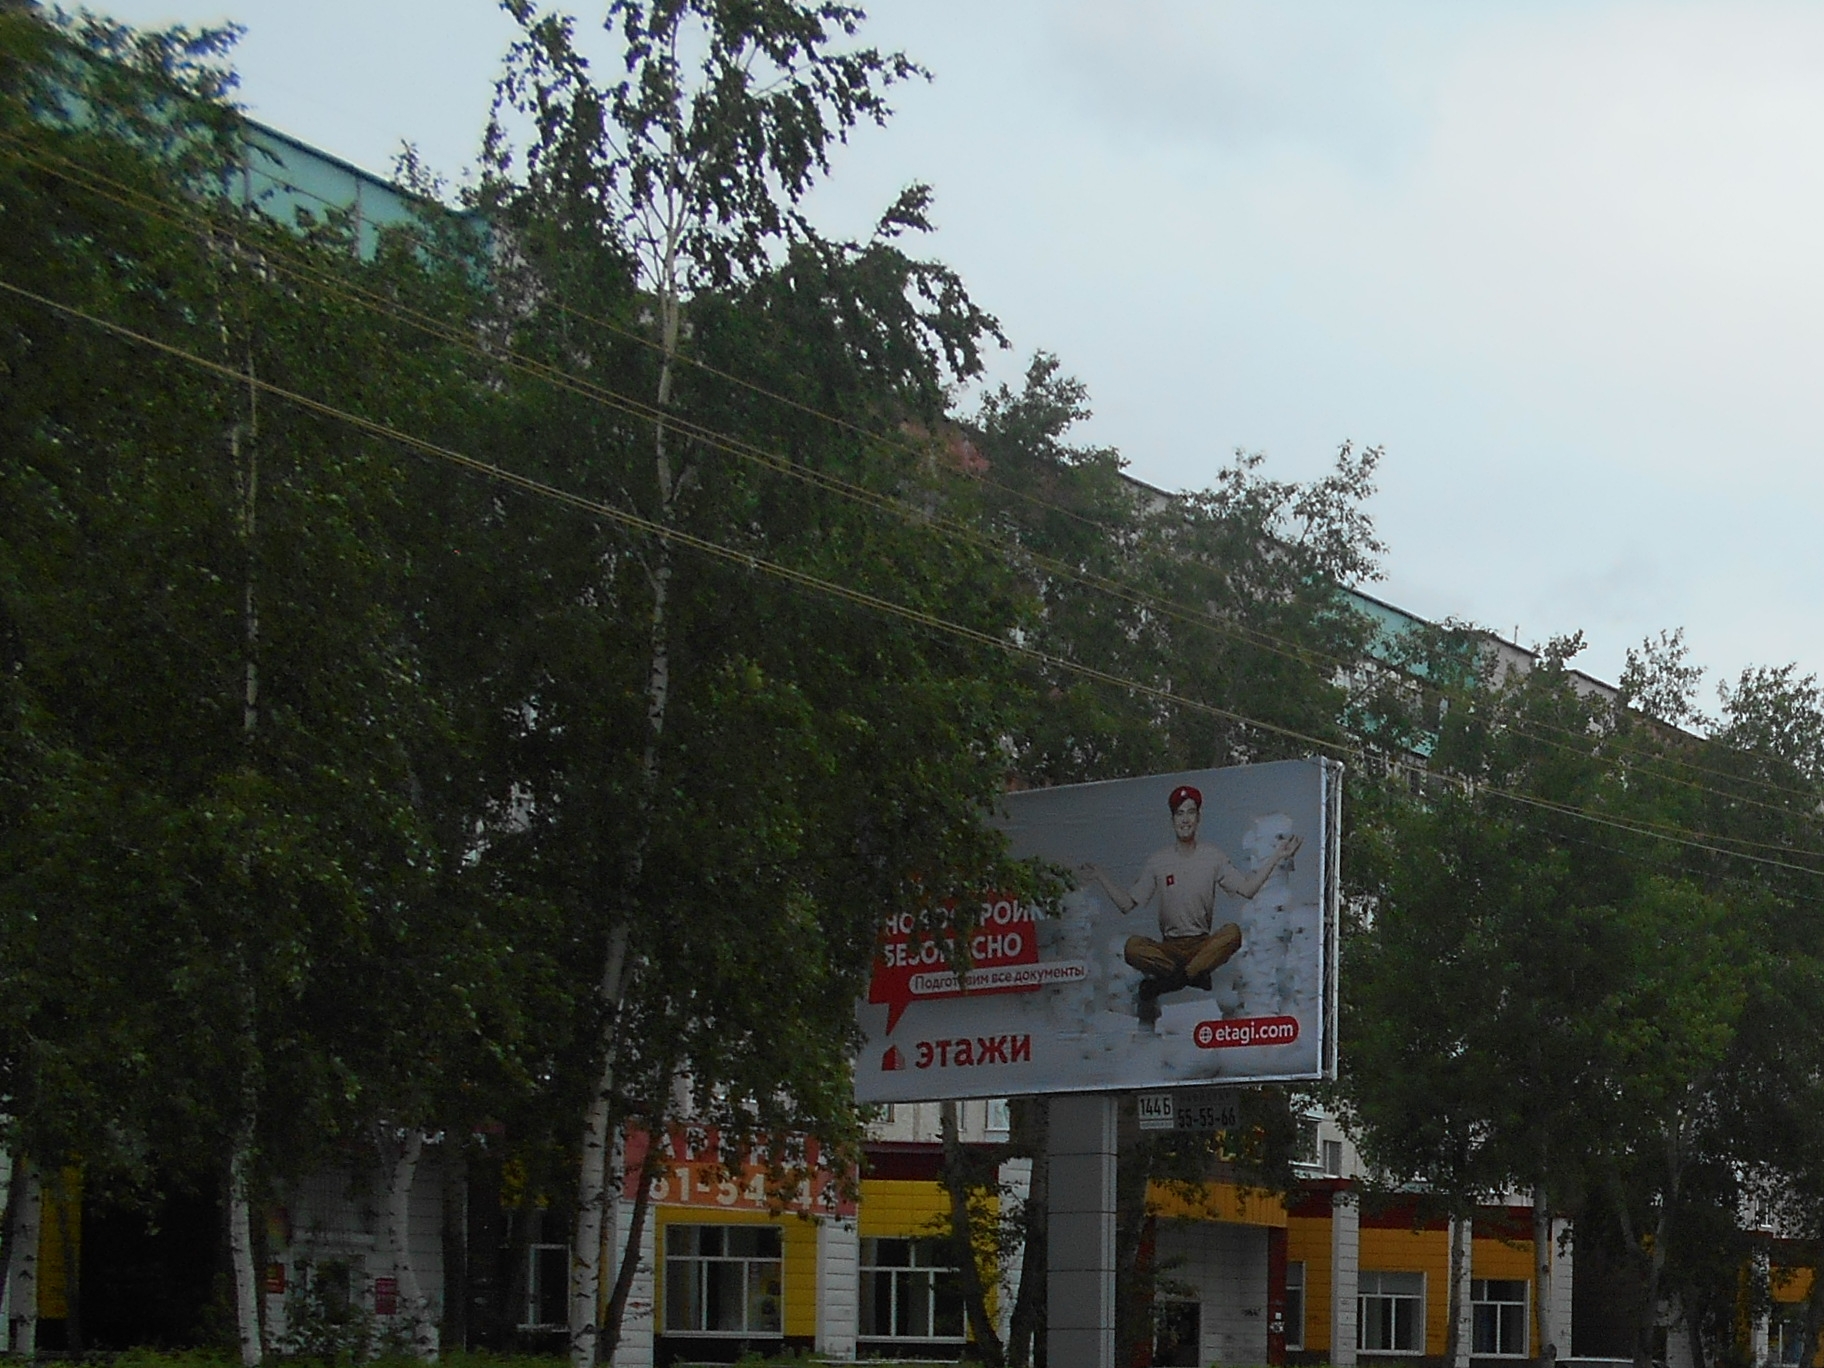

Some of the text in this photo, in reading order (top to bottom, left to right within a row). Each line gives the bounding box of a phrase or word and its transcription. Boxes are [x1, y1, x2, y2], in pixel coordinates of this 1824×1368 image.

[884, 932, 1022, 967] БЕЗОПСНО
[915, 965, 1085, 991] Подготвим все документы
[1215, 1022, 1294, 1044] etagi.com
[915, 1034, 1031, 1069] этажи
[1177, 1107, 1236, 1128] 55-55-66
